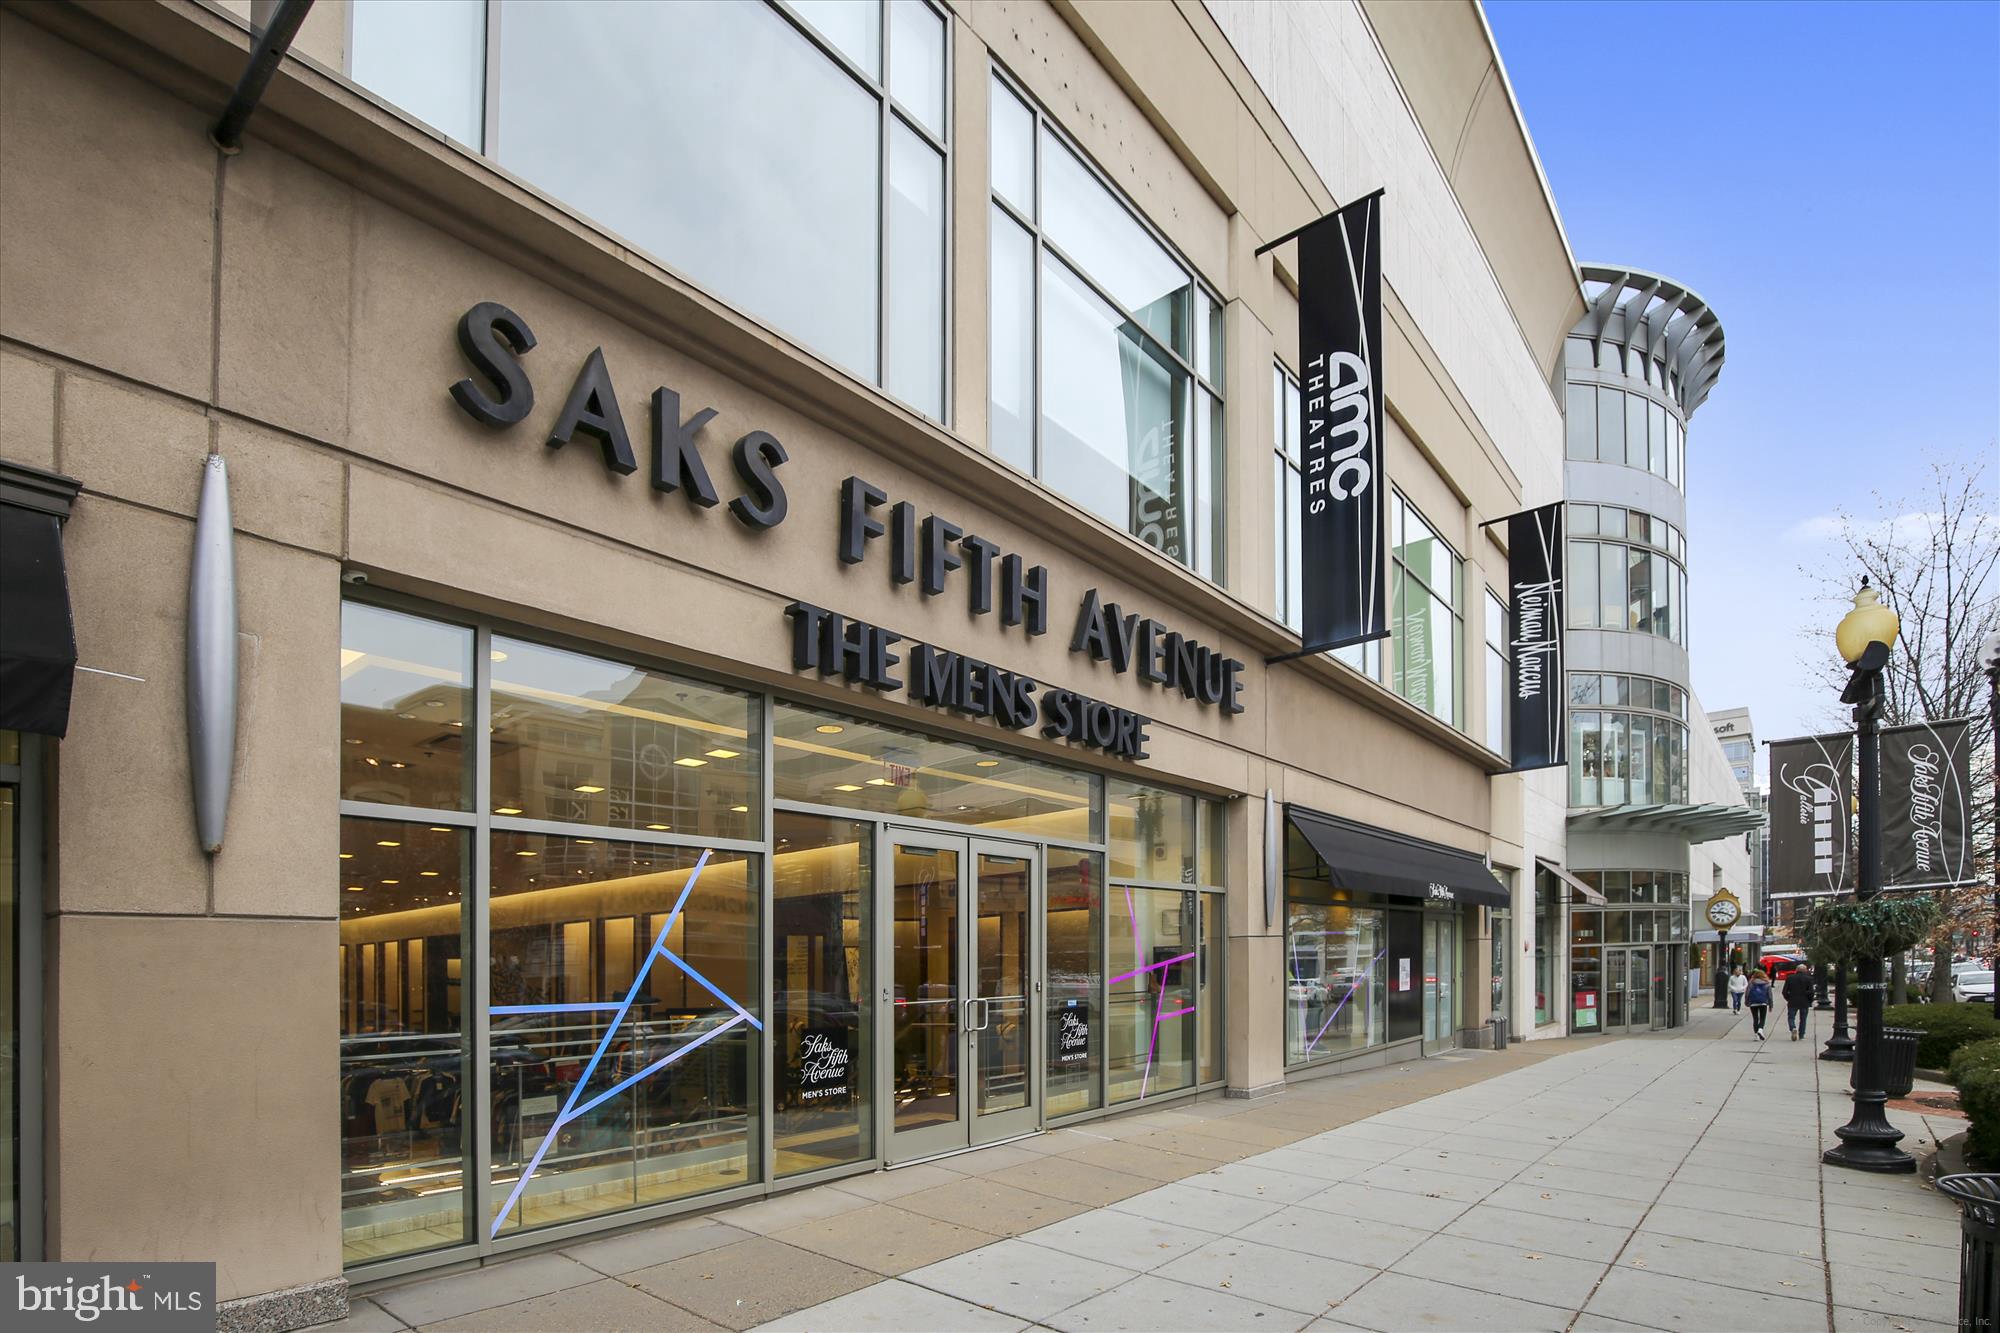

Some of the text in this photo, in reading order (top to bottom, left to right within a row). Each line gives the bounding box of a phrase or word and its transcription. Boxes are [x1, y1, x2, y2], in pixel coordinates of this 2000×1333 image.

[1308, 353, 1326, 514] THEATRES
[1329, 351, 1371, 501] amc
[449, 301, 1245, 715] SAKS FIFTH AVENUE
[784, 600, 1152, 761] THE MENS STORE
[1510, 578, 1562, 700] Neiman Marcus
[1907, 743, 1942, 872] Saks Fifth Avenue
[800, 1034, 833, 1059] Saks
[800, 1061, 845, 1085] Avenue
[801, 1086, 847, 1100] MEN'S STORE
[818, 1047, 849, 1070] Fifth
